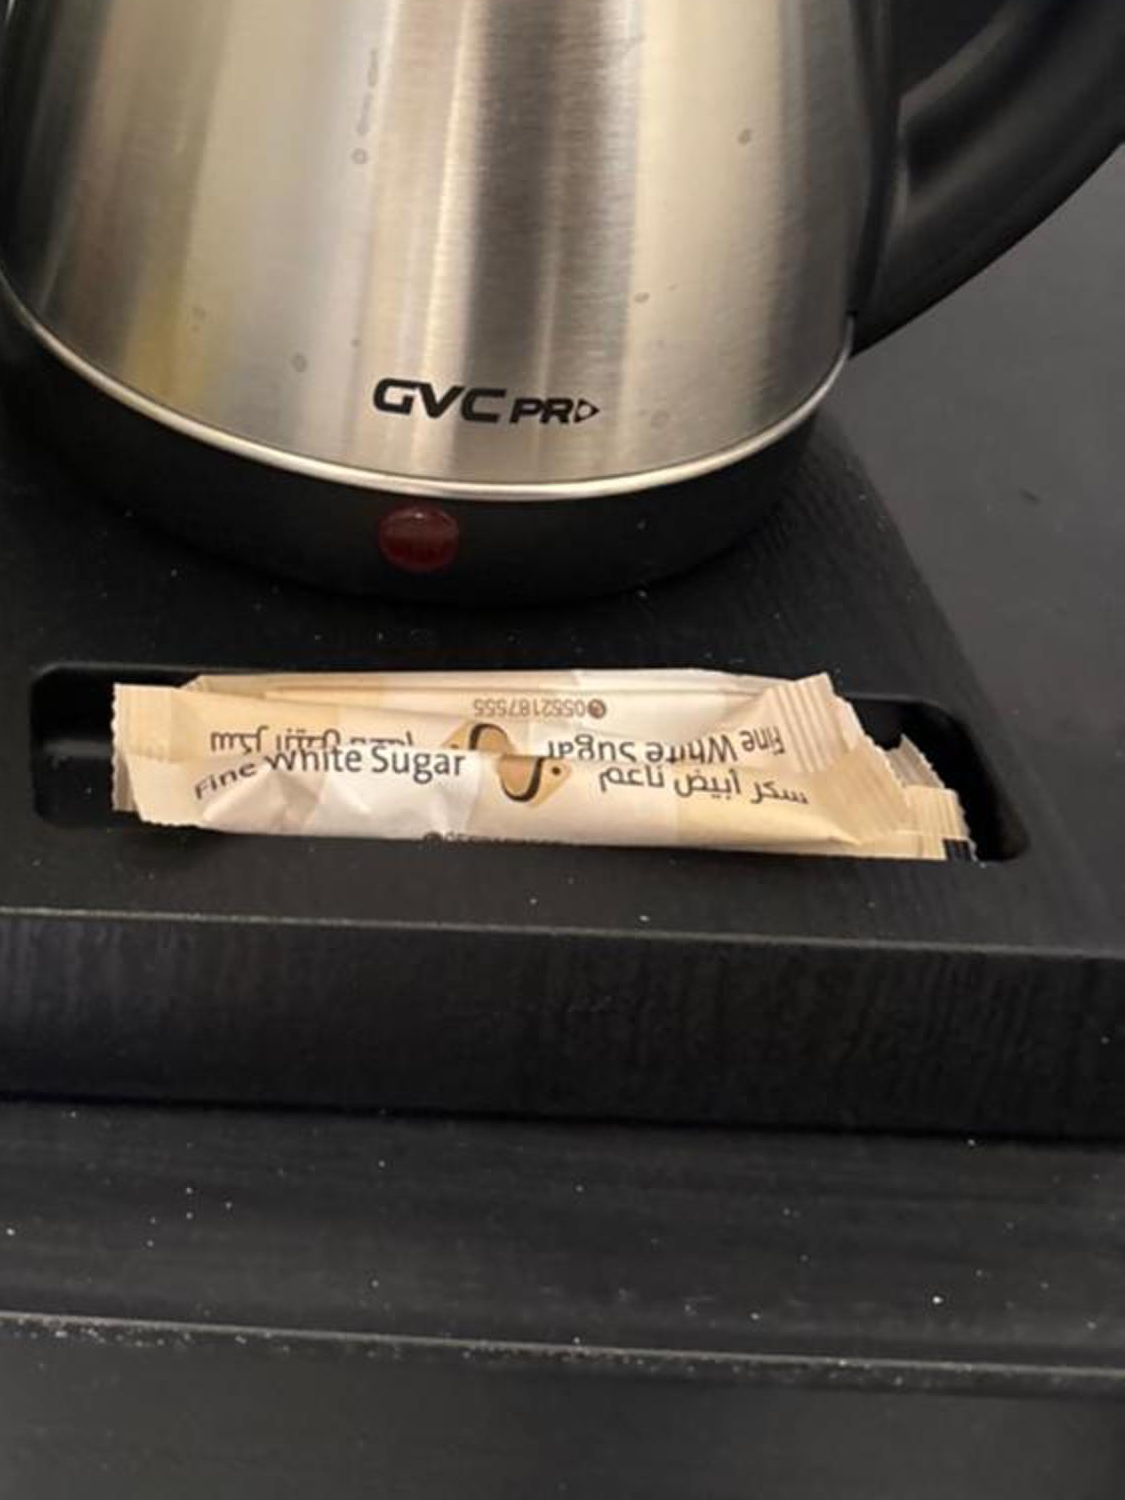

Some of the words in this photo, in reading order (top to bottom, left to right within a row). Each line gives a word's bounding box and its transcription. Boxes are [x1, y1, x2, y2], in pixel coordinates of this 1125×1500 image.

[372, 377, 507, 424] GVC
[473, 697, 587, 719] 0552187555
[645, 733, 738, 763] White
[741, 725, 787, 757] Fine
[193, 762, 257, 801] Fine
[265, 745, 363, 775] White
[370, 744, 466, 784] Sugar
